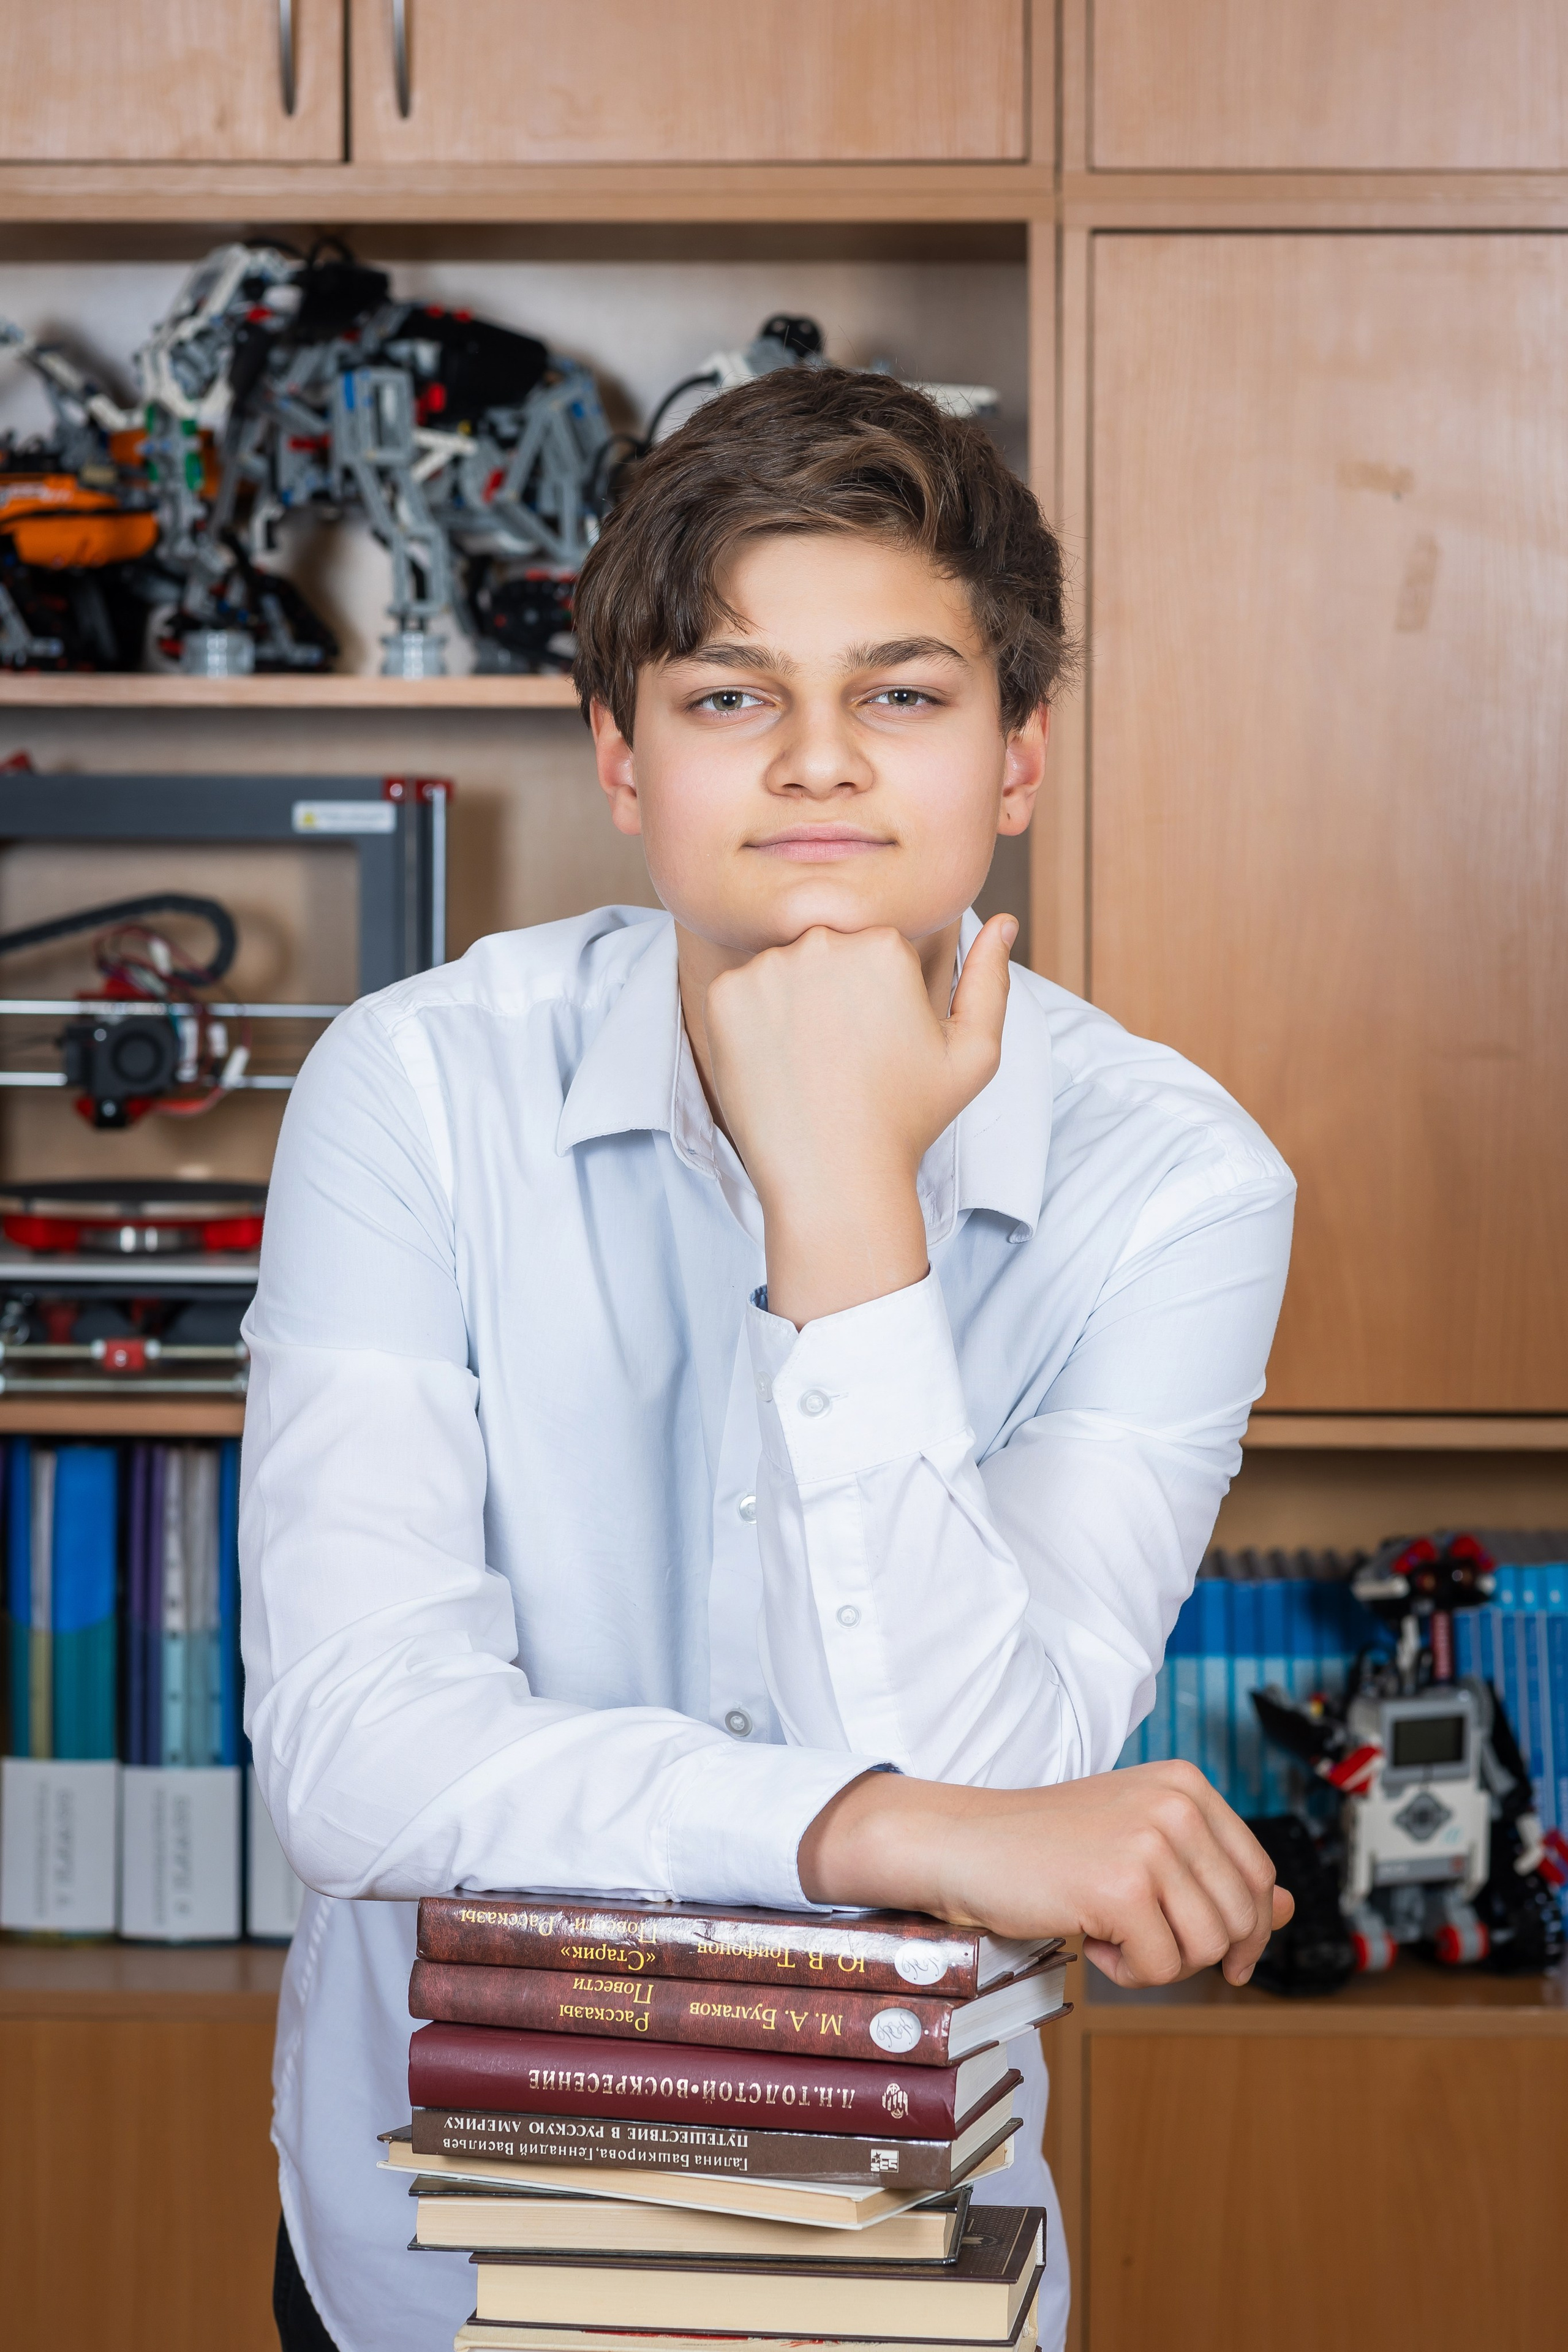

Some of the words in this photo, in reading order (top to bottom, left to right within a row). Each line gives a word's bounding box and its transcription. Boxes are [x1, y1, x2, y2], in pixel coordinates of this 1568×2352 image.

[460, 1908, 553, 1937] Рассказы
[573, 1916, 658, 1944] Повести
[560, 1942, 656, 1971] «Старик»
[695, 1939, 796, 1968] Трифонов
[571, 1977, 654, 2005] Повести
[559, 2003, 650, 2032] Рассказы
[688, 2001, 777, 2030] Булгаков
[783, 2009, 809, 2032] А.
[815, 2011, 844, 2036] М.
[443, 2115, 522, 2132] АМЕРИКУ
[528, 2120, 605, 2139] РУССКУЮ
[610, 2125, 620, 2139] В
[441, 2136, 514, 2156] Васильев
[626, 2126, 748, 2147] ПУТЕШЕСТВИЕ
[518, 2141, 594, 2161] Геннадий
[693, 2154, 748, 2172] Галина
